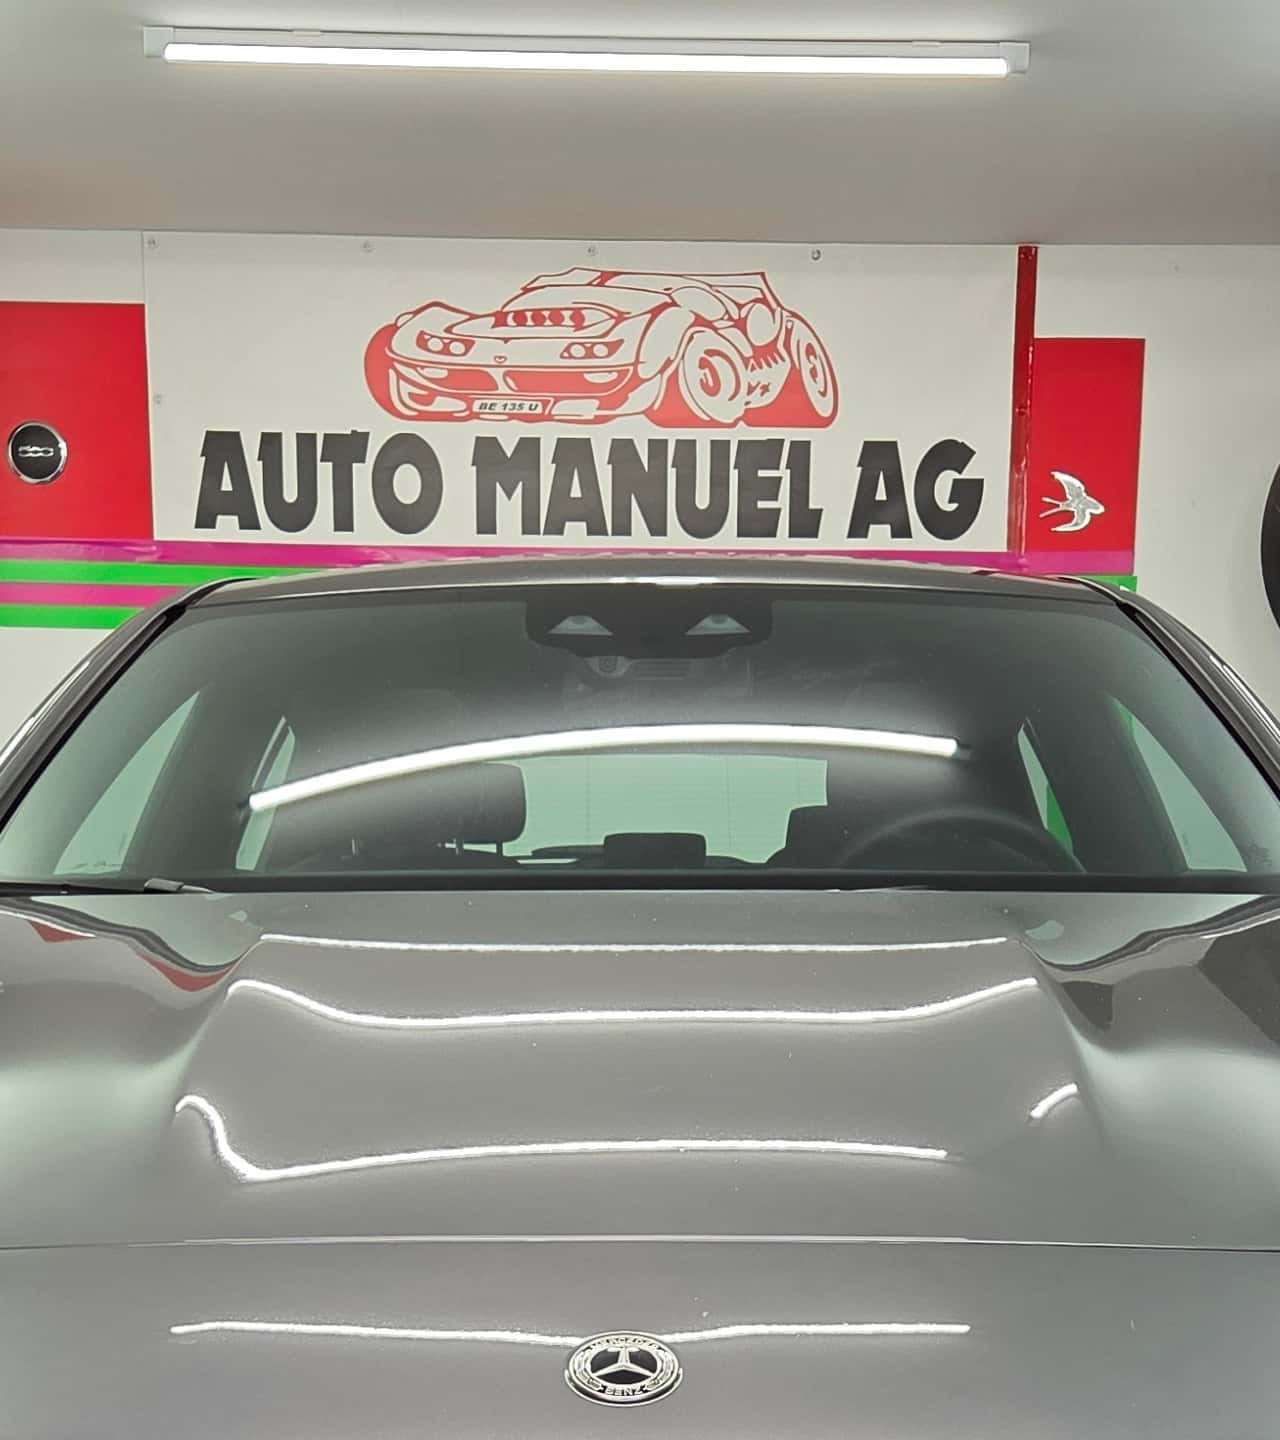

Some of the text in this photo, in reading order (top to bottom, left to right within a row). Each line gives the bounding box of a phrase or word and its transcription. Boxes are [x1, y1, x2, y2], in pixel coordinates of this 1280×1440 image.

[194, 428, 985, 541] AUTO MANUEL AG
